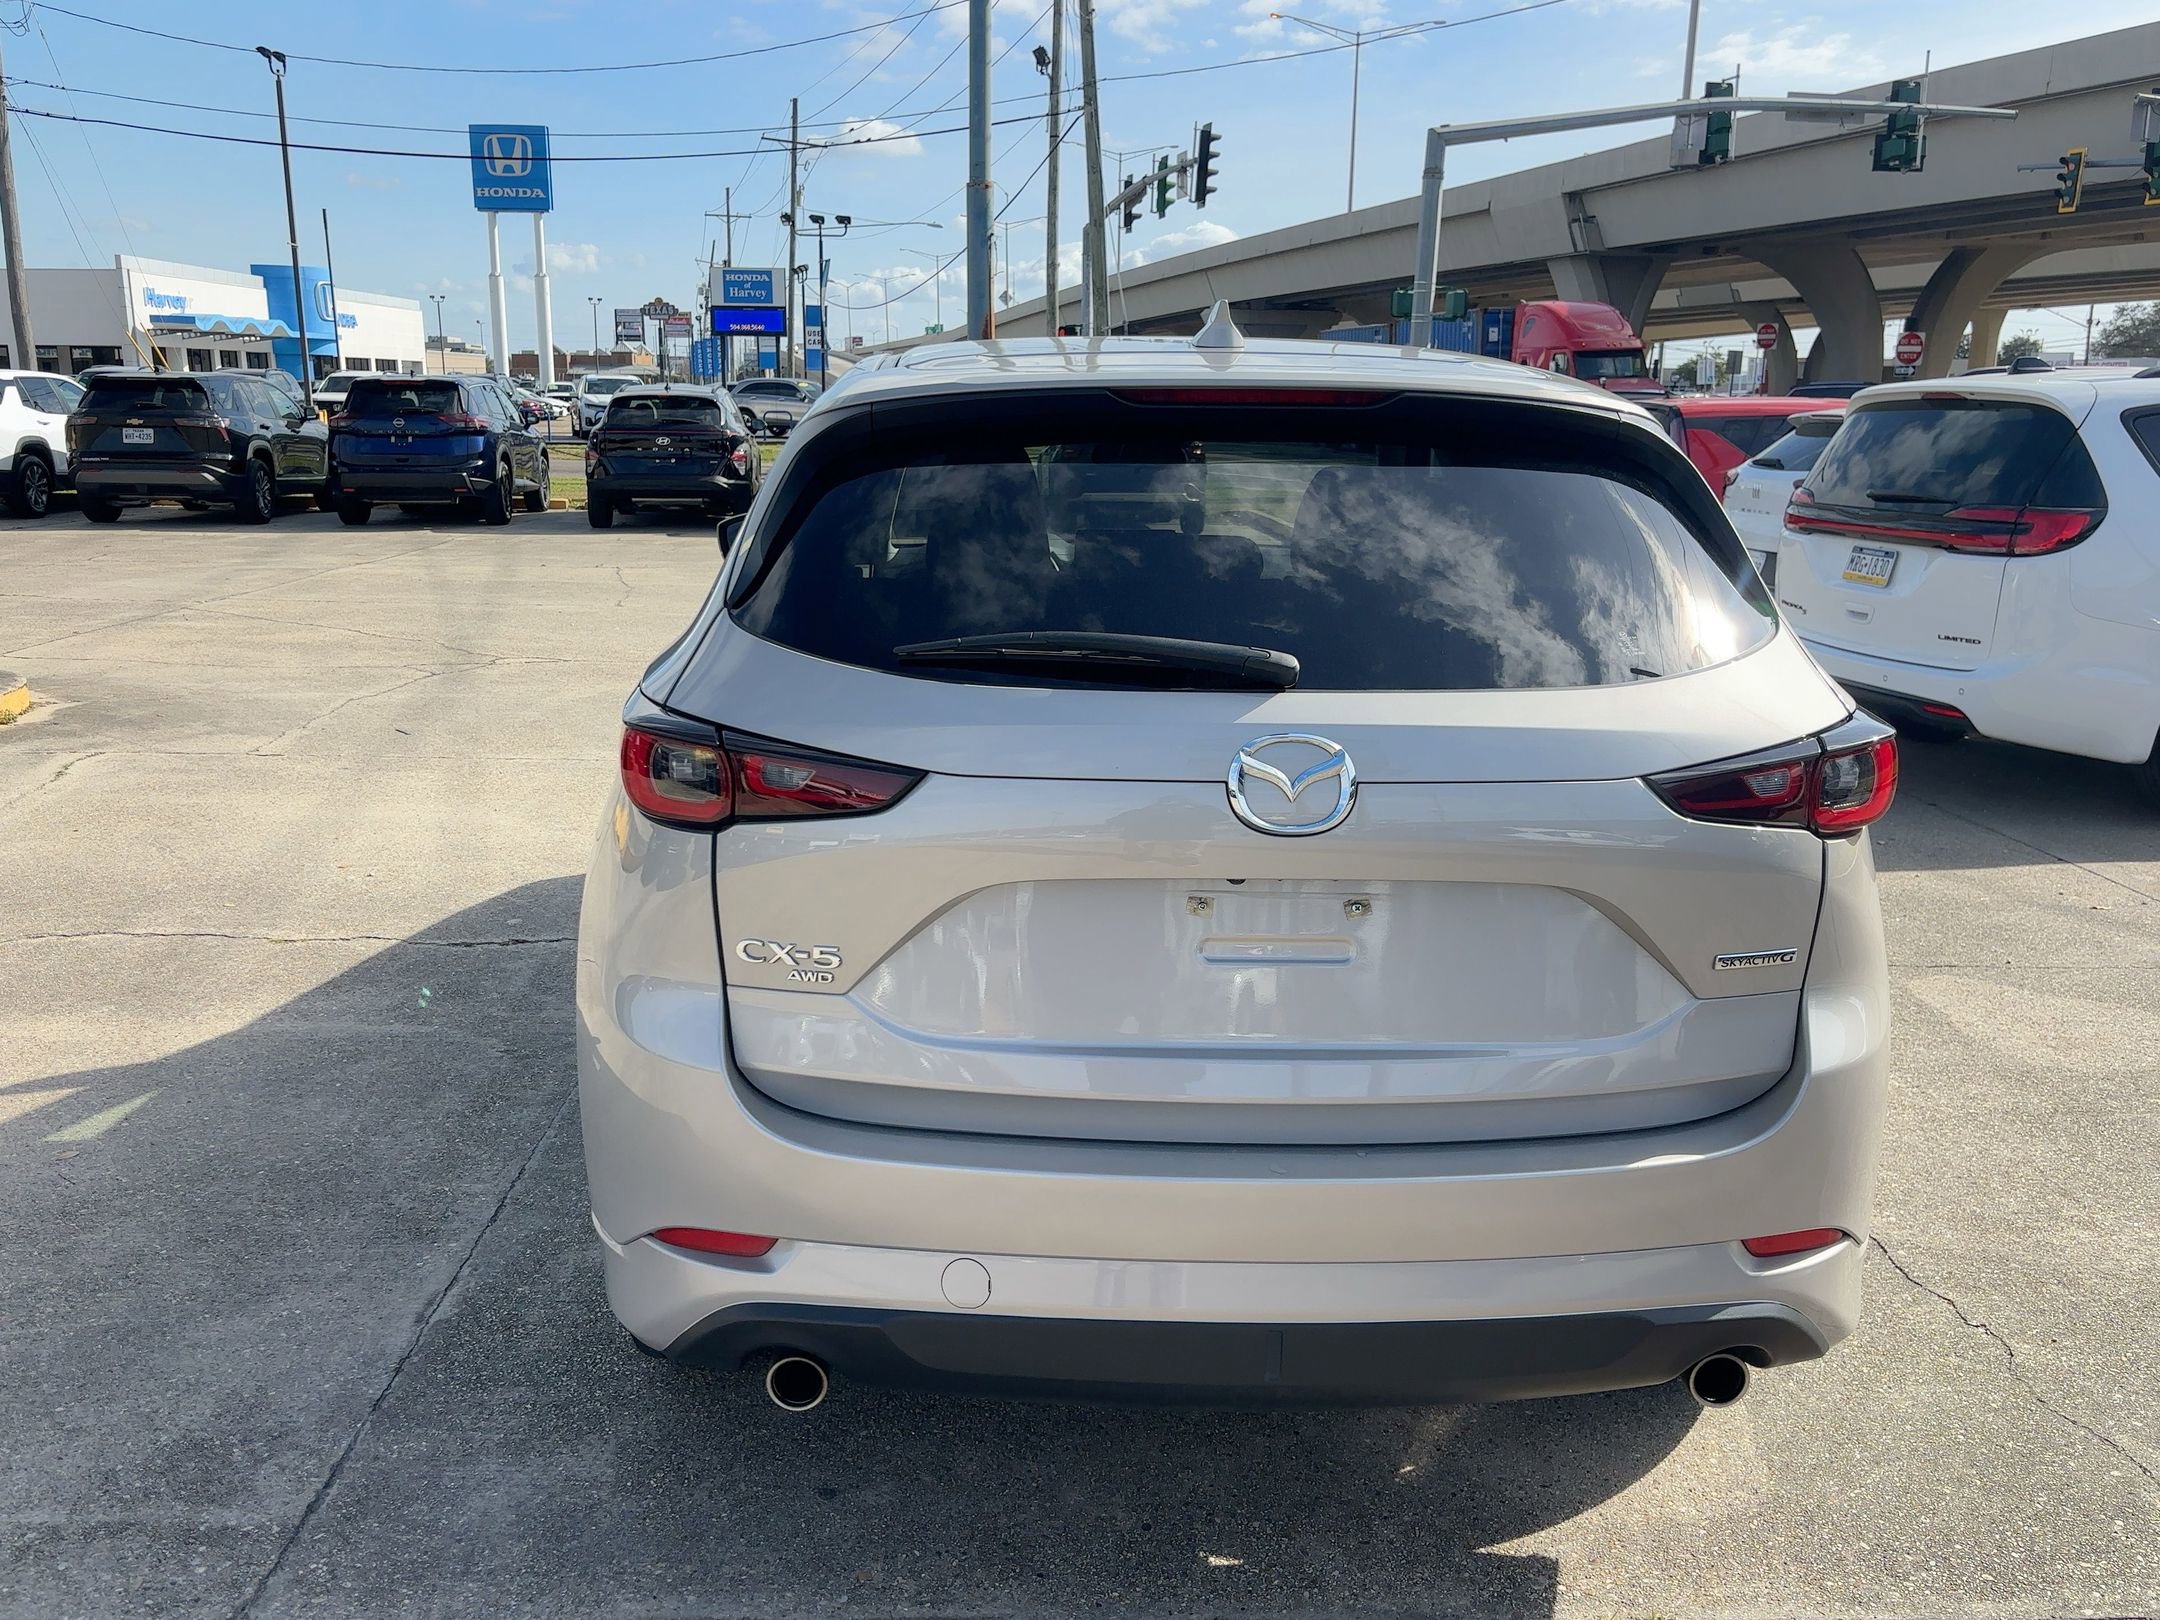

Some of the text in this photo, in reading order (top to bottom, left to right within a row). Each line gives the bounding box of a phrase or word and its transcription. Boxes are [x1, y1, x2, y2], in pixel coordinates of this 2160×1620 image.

[475, 187, 546, 199] HONDA
[725, 273, 770, 282] HONDA
[729, 287, 767, 300] Harvey
[645, 305, 674, 315] TEXAS
[1900, 352, 1917, 360] ENTER
[1937, 634, 1981, 645] LIMITED
[735, 938, 842, 969] CX-5
[787, 968, 834, 984] AWD
